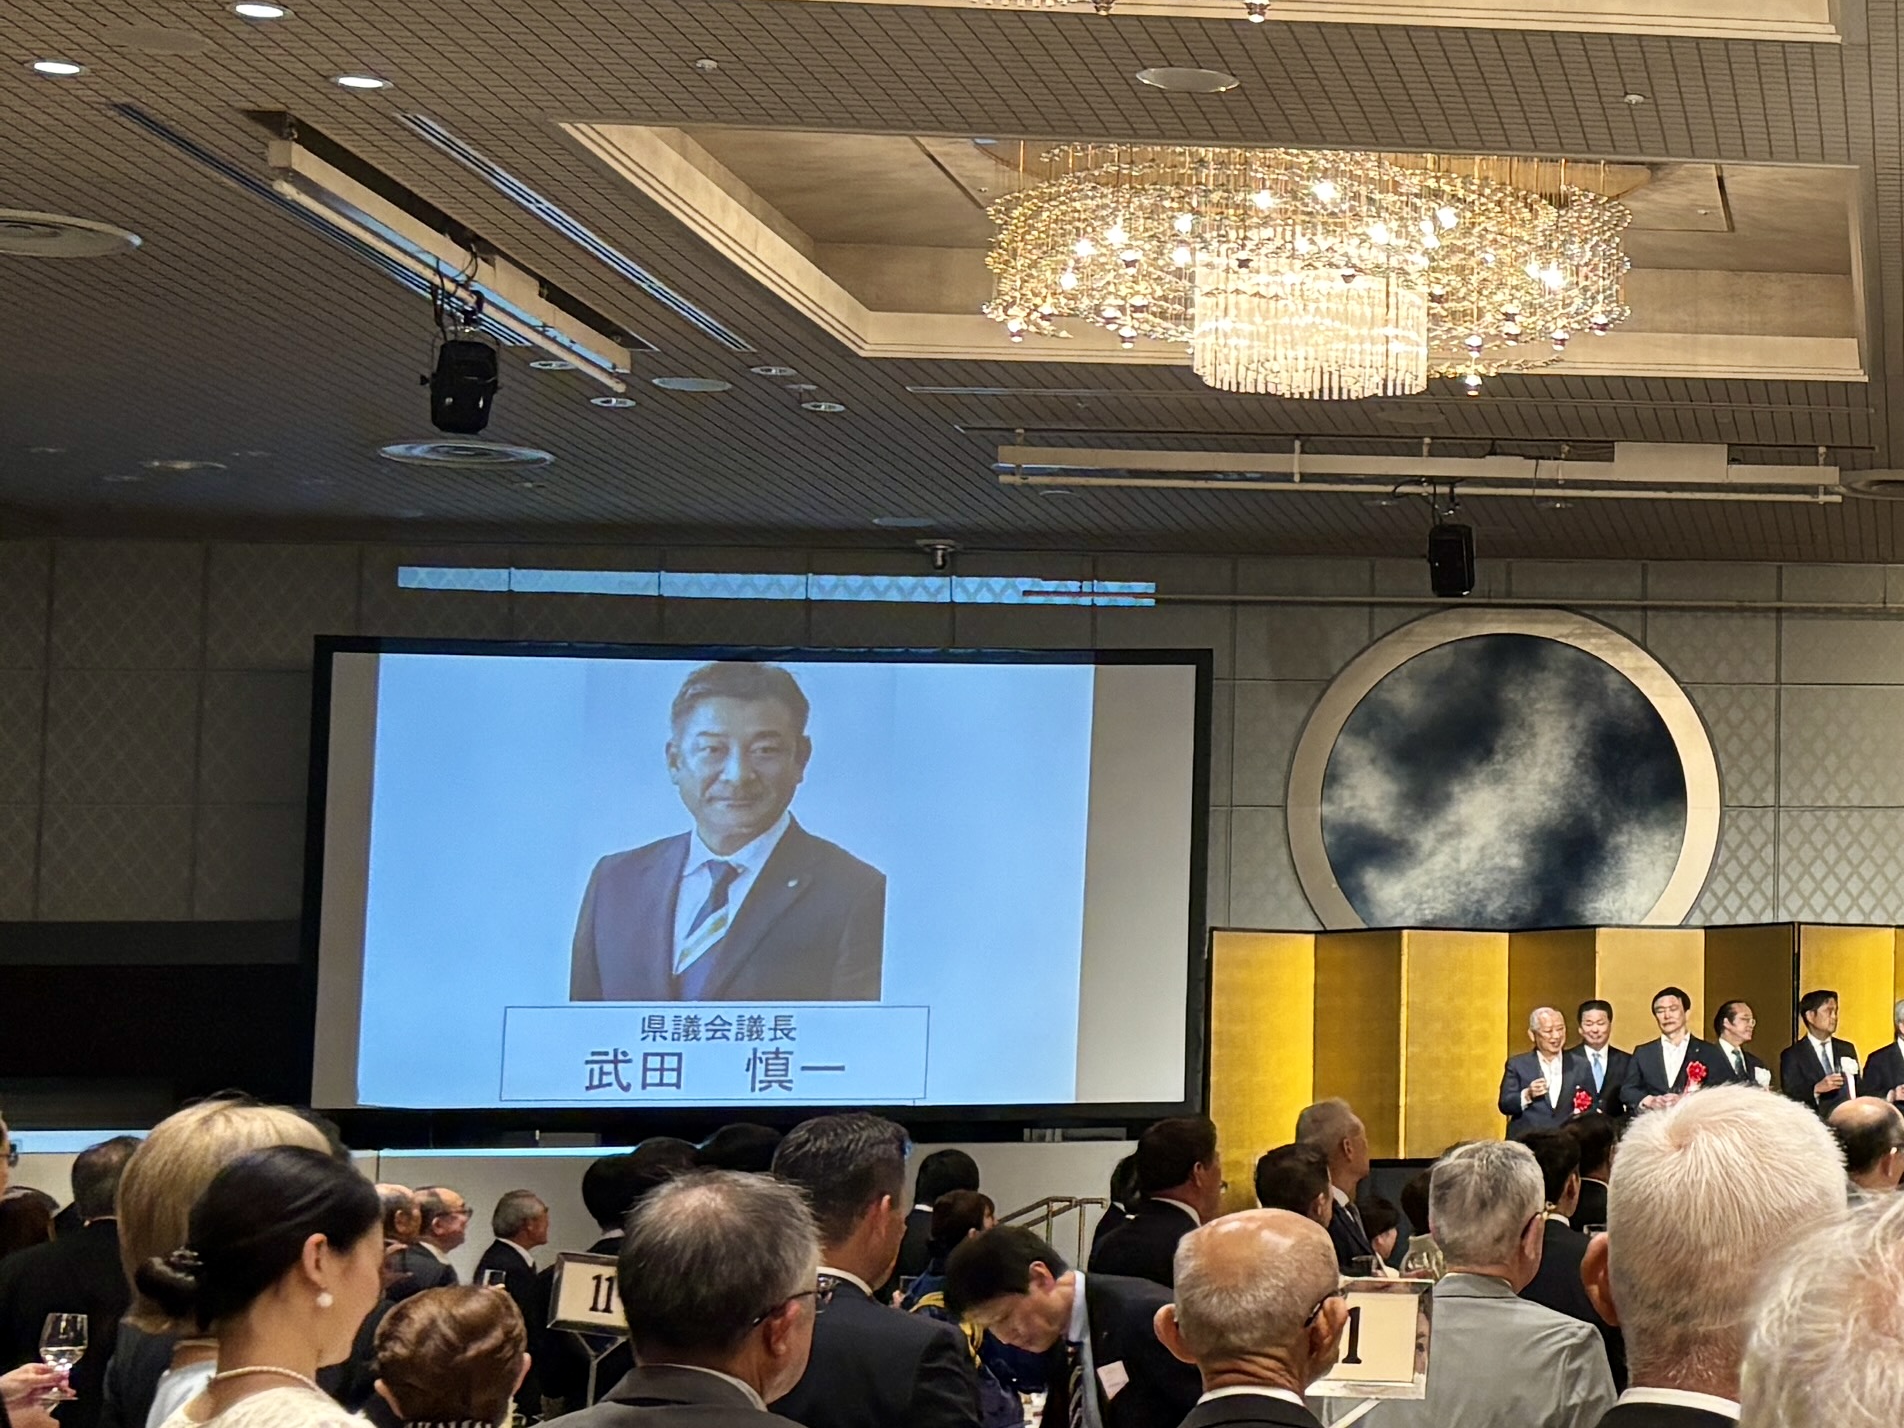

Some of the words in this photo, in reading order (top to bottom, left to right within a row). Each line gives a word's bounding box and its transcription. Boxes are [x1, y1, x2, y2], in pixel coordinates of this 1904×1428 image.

[639, 1013, 798, 1044] 県議会議長
[583, 1046, 684, 1093] 武田
[744, 1045, 847, 1093] 慎一
[589, 1274, 616, 1314] 11
